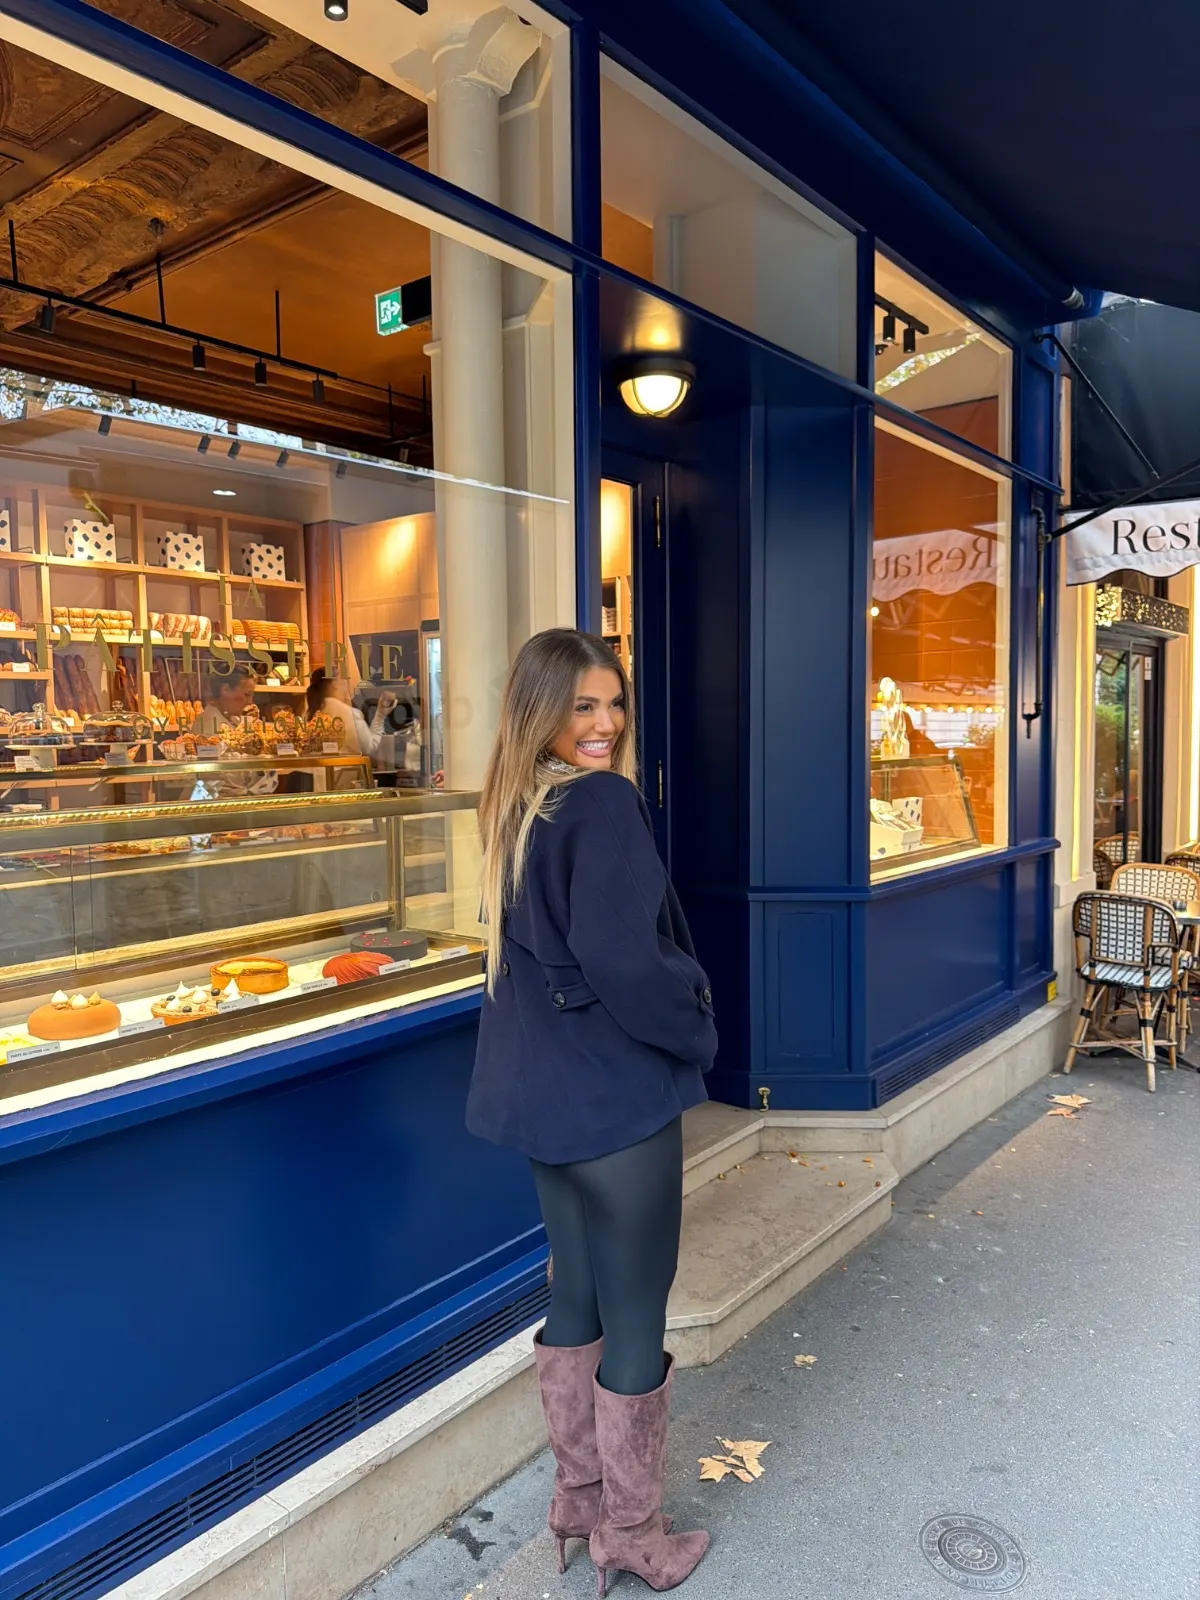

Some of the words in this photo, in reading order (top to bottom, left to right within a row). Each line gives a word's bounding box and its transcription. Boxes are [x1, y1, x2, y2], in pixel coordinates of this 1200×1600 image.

[218, 575, 265, 608] LA
[34, 613, 405, 681] PÂTISSERIE
[132, 716, 226, 737] CYRIL
[244, 715, 345, 734] LIGNAC
